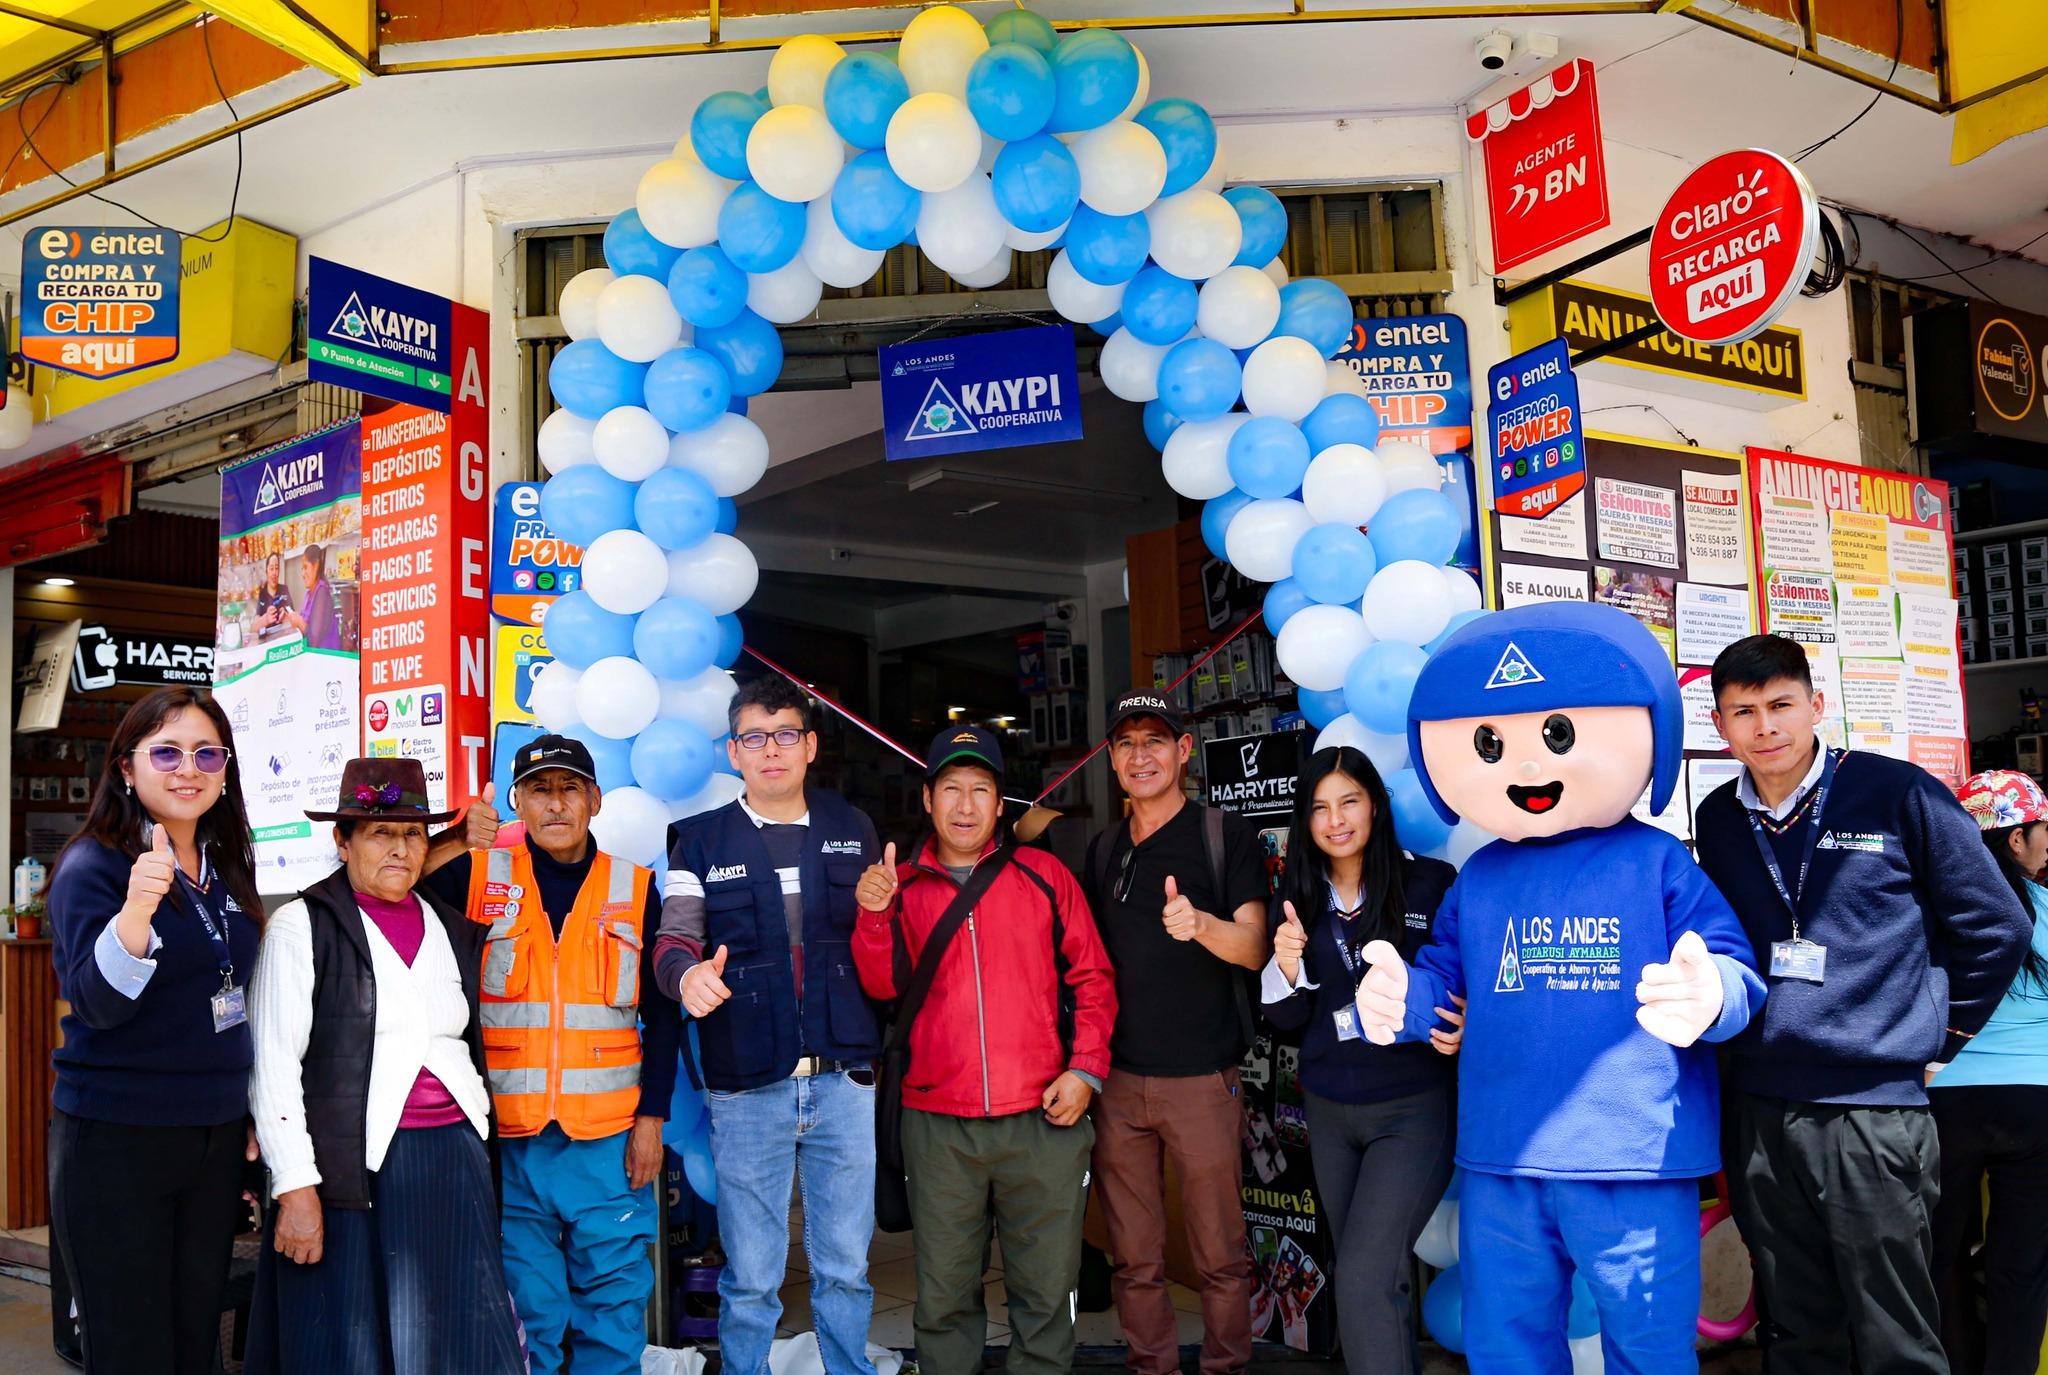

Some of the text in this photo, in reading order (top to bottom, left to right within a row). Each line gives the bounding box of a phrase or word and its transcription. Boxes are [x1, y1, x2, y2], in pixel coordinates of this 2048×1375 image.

[1513, 133, 1575, 177] AGENTE
[1544, 155, 1587, 201] BN
[1670, 190, 1754, 240] Claro
[1667, 222, 1782, 286] RECARGA
[46, 264, 156, 280] COMPRA Y
[43, 285, 157, 297] RECARGA TU
[1699, 266, 1753, 312] AQUÍ
[44, 302, 154, 333] CHIP
[371, 305, 437, 350] KAYPI
[1376, 322, 1450, 346] entel
[61, 338, 136, 371] aquí
[381, 337, 437, 362] COOPERATIVA
[905, 353, 955, 366] LOS ANDES
[1721, 338, 1793, 379] AQUÍ
[1984, 348, 2013, 366] Fabian
[330, 350, 405, 377] Punto de Atención
[1337, 354, 1443, 374] OMPRA Y
[1522, 357, 1561, 388] entel
[1981, 364, 2014, 382] Valencia
[1424, 375, 1447, 388] TU
[961, 374, 1061, 416] KAYPI
[979, 409, 1063, 430] COOPERATIVA
[1498, 393, 1558, 431] PREPAGO
[371, 411, 447, 452] TRANSFERENCIAS
[1498, 406, 1572, 457] POWER
[277, 451, 324, 489] KAYPI
[372, 445, 442, 484] DEPÓSITOS
[285, 478, 324, 502] COOPERATIVA
[372, 483, 425, 517] RETIROS
[1521, 483, 1558, 511] aquí
[1616, 484, 1622, 492] SE
[1686, 486, 1734, 504] SE ALQUILA
[1600, 493, 1672, 519] SEÑORITAS
[1687, 504, 1737, 516] LOCAL COMERCIAL
[1600, 509, 1631, 521] CAJERAS
[1640, 516, 1673, 528] MESERAS
[372, 514, 438, 550] RECARGAS
[1695, 533, 1738, 546] 952 654 335
[1610, 544, 1673, 562] CEL: 930 209 721
[1696, 547, 1738, 559] 936 541 887
[372, 549, 433, 584] PAGOS DE
[458, 346, 486, 796] AGENT
[372, 583, 437, 617] SERVICIOS
[1506, 582, 1584, 600] SE ALQUILA
[1699, 592, 1728, 604] URGENTE
[1770, 583, 1829, 601] SEÑORITAS
[1770, 599, 1796, 607] CAJERAS
[1803, 601, 1832, 610] MESERAS
[372, 620, 425, 651] RETIROS
[1822, 634, 1834, 642] 721
[162, 669, 206, 681] SERVICIO
[372, 654, 423, 686] DE YAPE
[319, 707, 338, 718] Pago
[1118, 696, 1167, 711] PRENSA
[1211, 776, 1298, 802] HARRYTEC
[1248, 798, 1294, 810] Personalización
[719, 864, 746, 877] KAYPI
[1522, 917, 1620, 944] LOS ANDES
[1522, 947, 1620, 958] COTARUSI AYMARAES
[1523, 962, 1621, 977] Cooperativa de Ahorro y Crédito
[1547, 976, 1589, 990] Patrimonio de
[1242, 1187, 1316, 1215] enueva
[1242, 1211, 1317, 1234] carcasa AQUÍ
